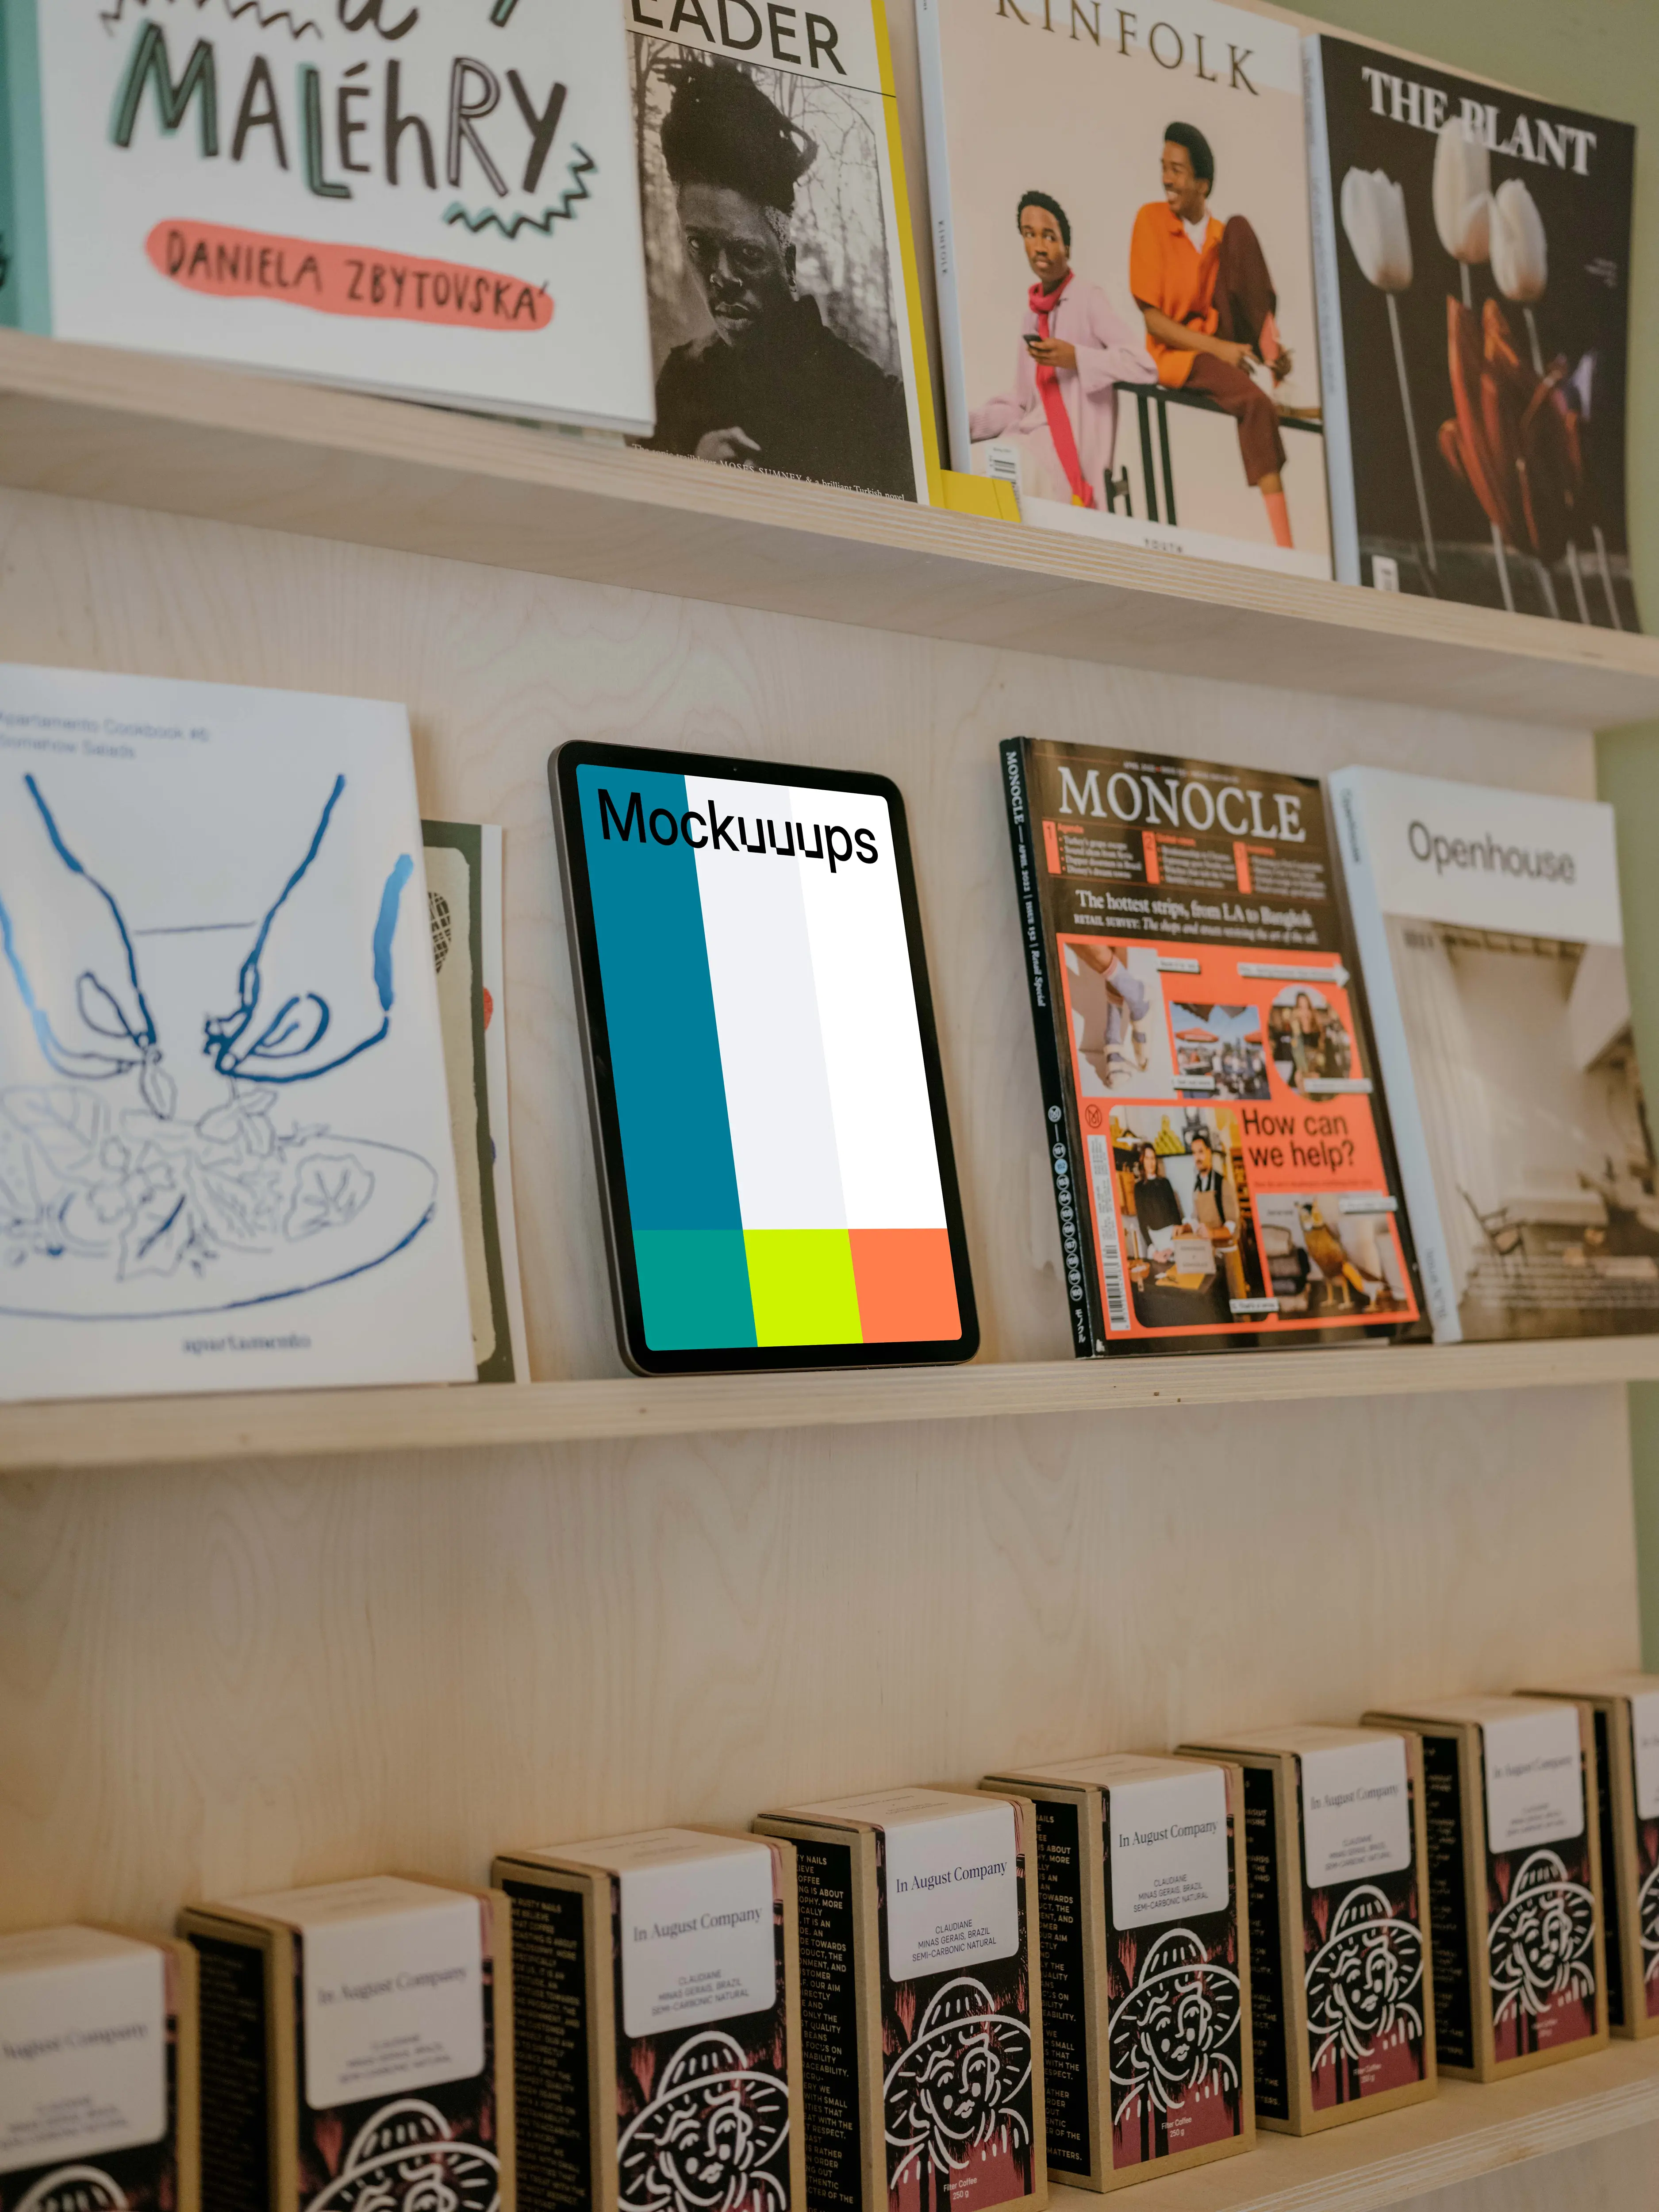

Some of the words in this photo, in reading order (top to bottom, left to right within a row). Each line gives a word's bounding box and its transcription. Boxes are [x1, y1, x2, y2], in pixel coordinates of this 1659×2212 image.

[1361, 66, 1448, 134] THE
[1459, 97, 1597, 176] PLANT
[166, 228, 323, 293] DANIELA
[720, 460, 754, 472] MOSES
[759, 467, 802, 481] SUMNEY
[822, 479, 852, 491] brilliant
[853, 485, 882, 497] Turkish
[0, 709, 100, 733] partamento
[1006, 751, 1025, 825] MONOCLE
[1058, 765, 1306, 843] MONOCLE
[1407, 818, 1577, 884] Openhouse
[1075, 889, 1105, 909] The
[1106, 892, 1150, 914] hottest
[1242, 1108, 1294, 1135] How
[1304, 1115, 1348, 1136] can
[1248, 1147, 1284, 1167] we
[1290, 1139, 1354, 1174] help?
[1119, 1834, 1129, 1847] In
[1133, 1828, 1168, 1846] August
[1171, 1820, 1218, 1838] Company
[1047, 1845, 1071, 1855] ABOUT
[807, 1855, 827, 1866] NAILS
[1050, 1855, 1070, 1864] MORE
[798, 1874, 820, 1885] OFFEE
[896, 1879, 908, 1893] In
[911, 1871, 951, 1890] August
[954, 1862, 1007, 1881] Company
[820, 1888, 844, 1899] ABOUT
[822, 1899, 843, 1909] MORE
[1056, 1905, 1070, 1913] THE
[633, 1925, 648, 1942] In
[651, 1918, 698, 1939] August
[700, 1907, 763, 1929] Company
[821, 1920, 830, 1928] AN
[1059, 1915, 1074, 1924] AND
[935, 1919, 972, 1934] CLAUDIANE
[918, 1938, 939, 1949] MINAS
[941, 1932, 966, 1944] GERAIS,
[968, 1927, 990, 1939] BRAZIL
[811, 1939, 846, 1951] TOWARDS
[912, 1943, 965, 1962] SEMI-CARBONIC
[967, 1937, 997, 1950] NATURAL
[800, 1948, 827, 1960] ODUCT,
[829, 1951, 842, 1961] THE
[831, 1962, 846, 1972] AND
[801, 1968, 830, 1980] STOMER
[810, 1981, 825, 1989] OUR
[828, 1983, 840, 1992] AIM
[802, 1989, 830, 2001] IRECTLY
[823, 2013, 837, 2023] THE
[810, 2021, 841, 2034] QUALITY
[804, 2030, 827, 2041] BEANS
[832, 2046, 842, 2055] ON
[1051, 2040, 1075, 2051] SMALL
[803, 2052, 836, 2064] NABILITY
[803, 2061, 849, 2077] RACEABILITY.
[1066, 2062, 1080, 2071] THE
[824, 2097, 848, 2108] SMALL
[824, 2107, 843, 2117] THAT
[818, 2117, 837, 2126] WITH
[838, 2120, 853, 2130] THE
[1067, 2131, 1081, 2140] THE
[1169, 2129, 1180, 2138] 250
[814, 2146, 842, 2159] RATHER
[814, 2157, 838, 2169] ORDER
[943, 2183, 957, 2193] Filter
[959, 2177, 977, 2188] Coffee
[840, 2193, 854, 2204] THE
[953, 2190, 964, 2200] 250
[965, 2190, 969, 2198] g
